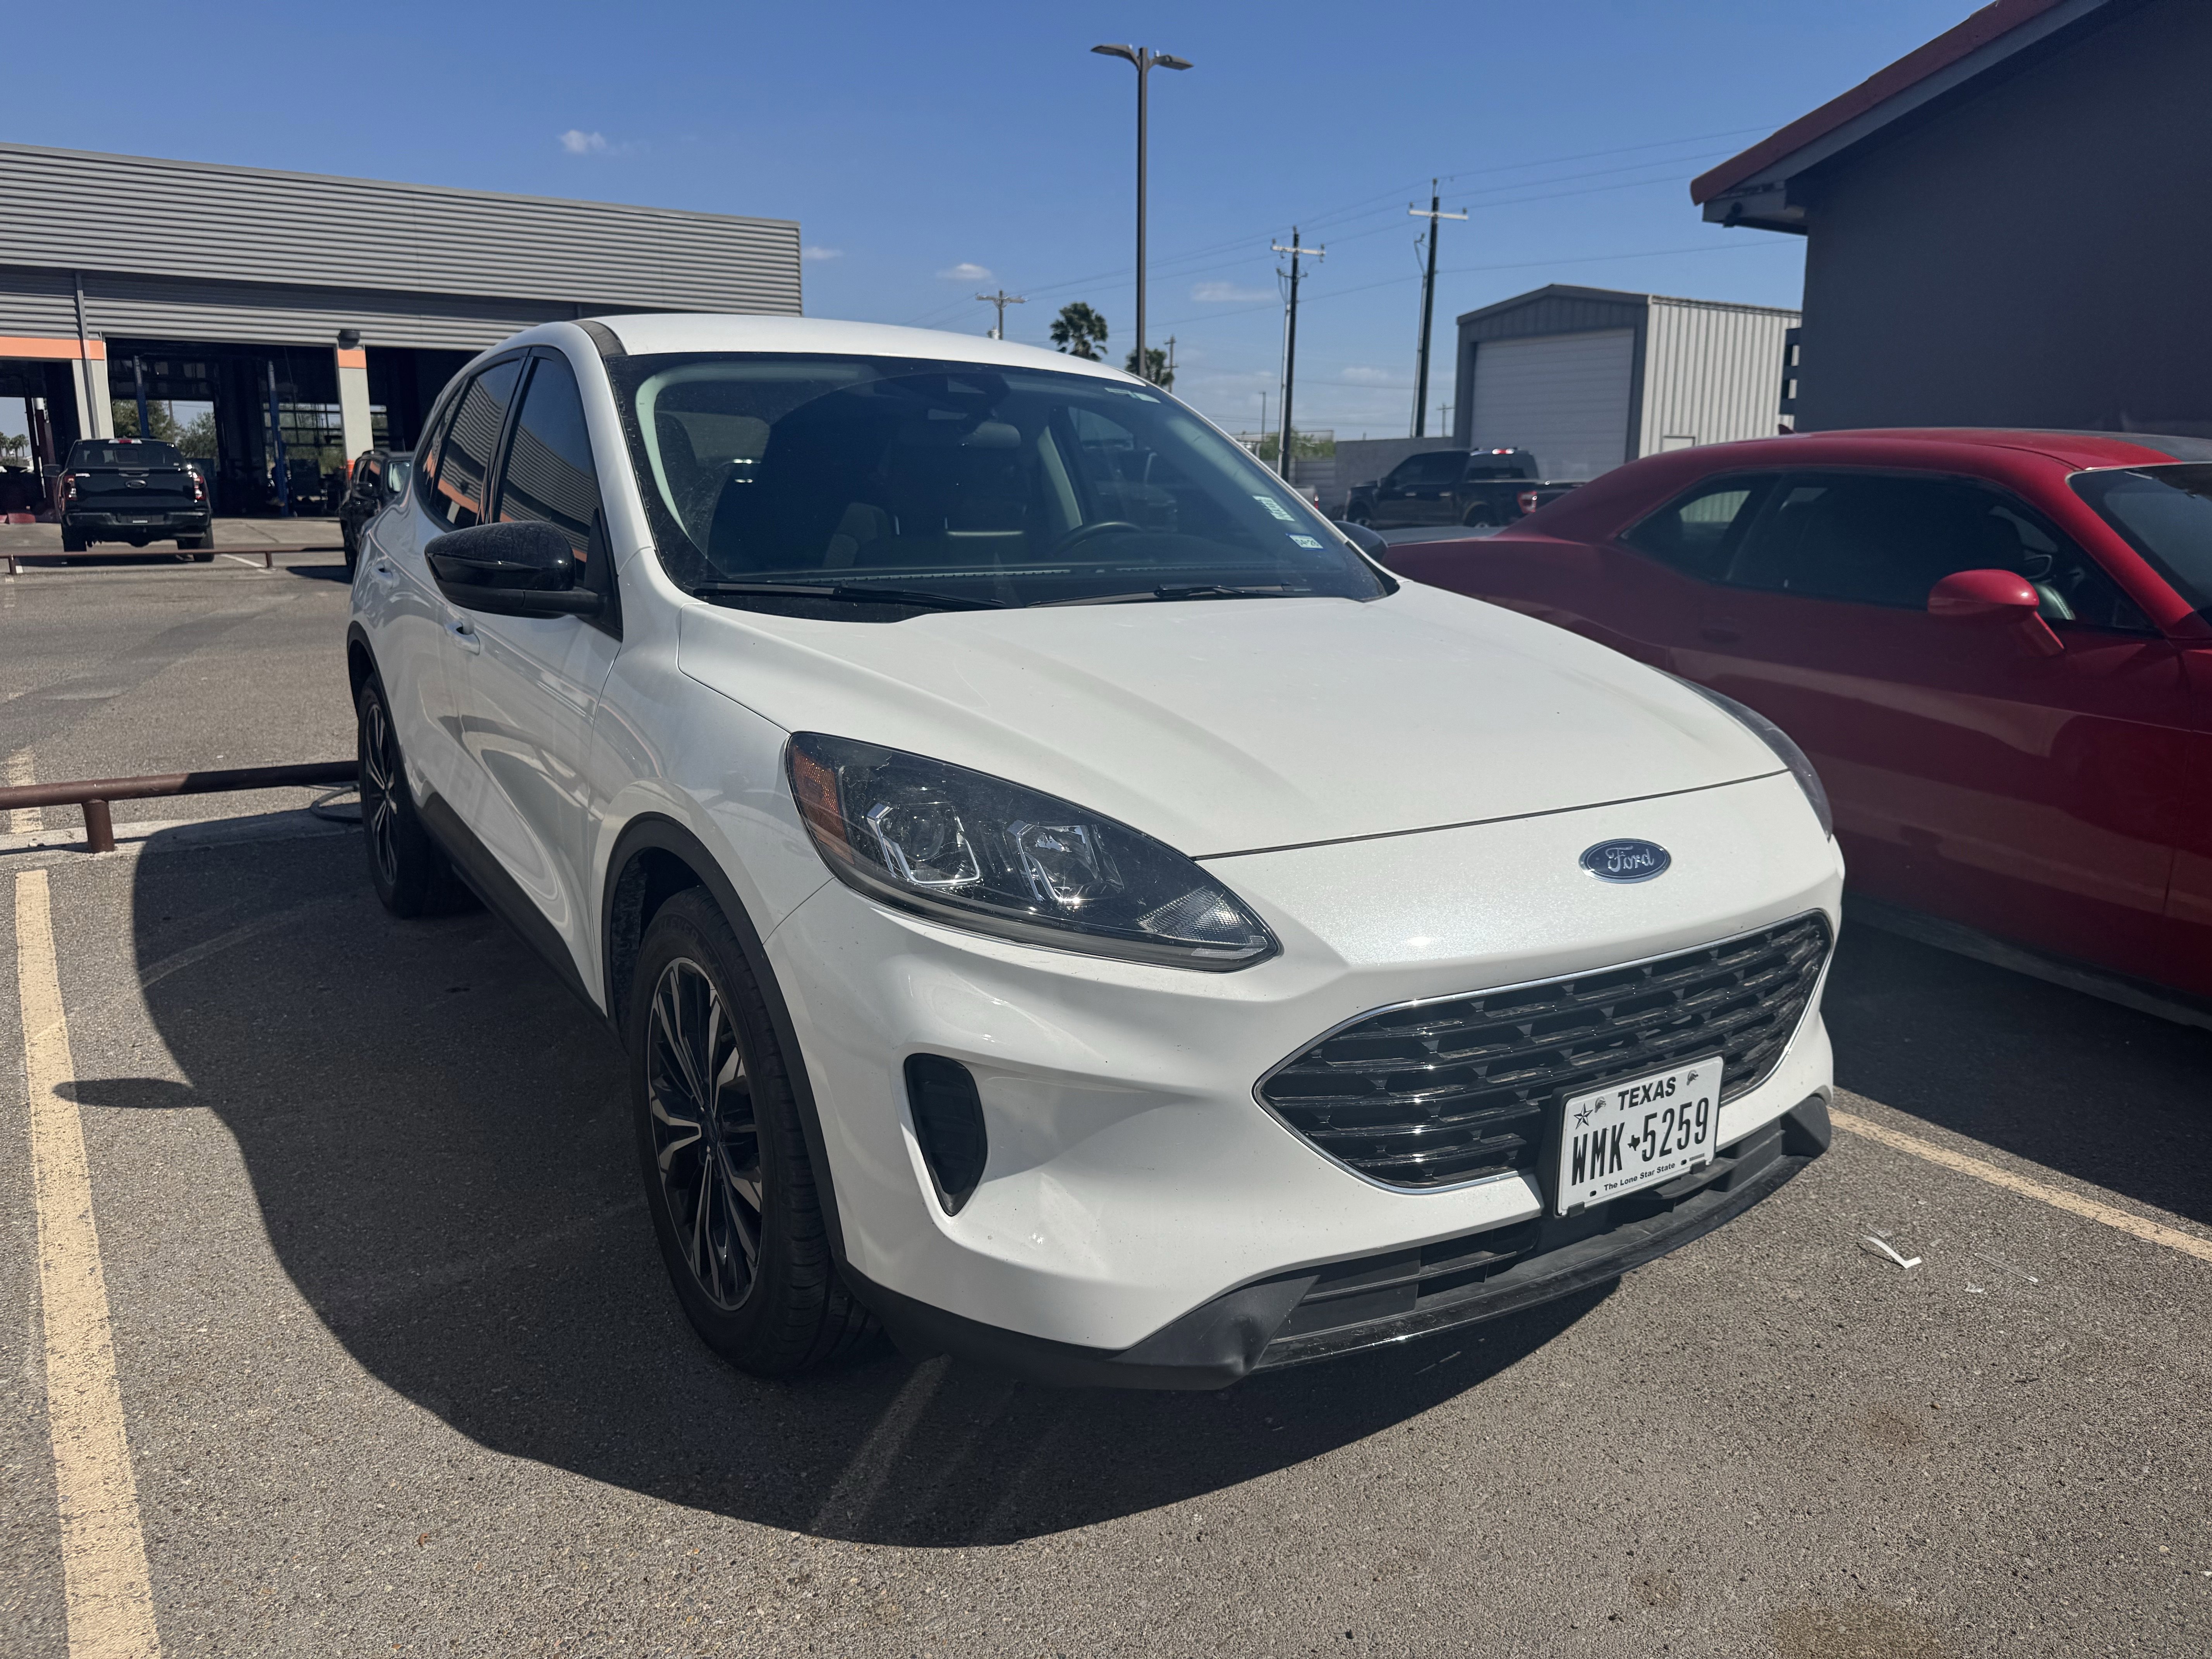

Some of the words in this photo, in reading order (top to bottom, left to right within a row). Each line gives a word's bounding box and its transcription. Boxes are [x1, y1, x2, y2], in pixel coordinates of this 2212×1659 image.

[1605, 846, 1654, 872] Ford
[1618, 1077, 1676, 1111] TEXAS
[1571, 1122, 1625, 1186] WMK
[1642, 1097, 1709, 1162] 5259
[1604, 1182, 1618, 1191] The
[1620, 1176, 1638, 1186] Lone
[1640, 1169, 1654, 1179] Star
[1657, 1162, 1676, 1173] State
